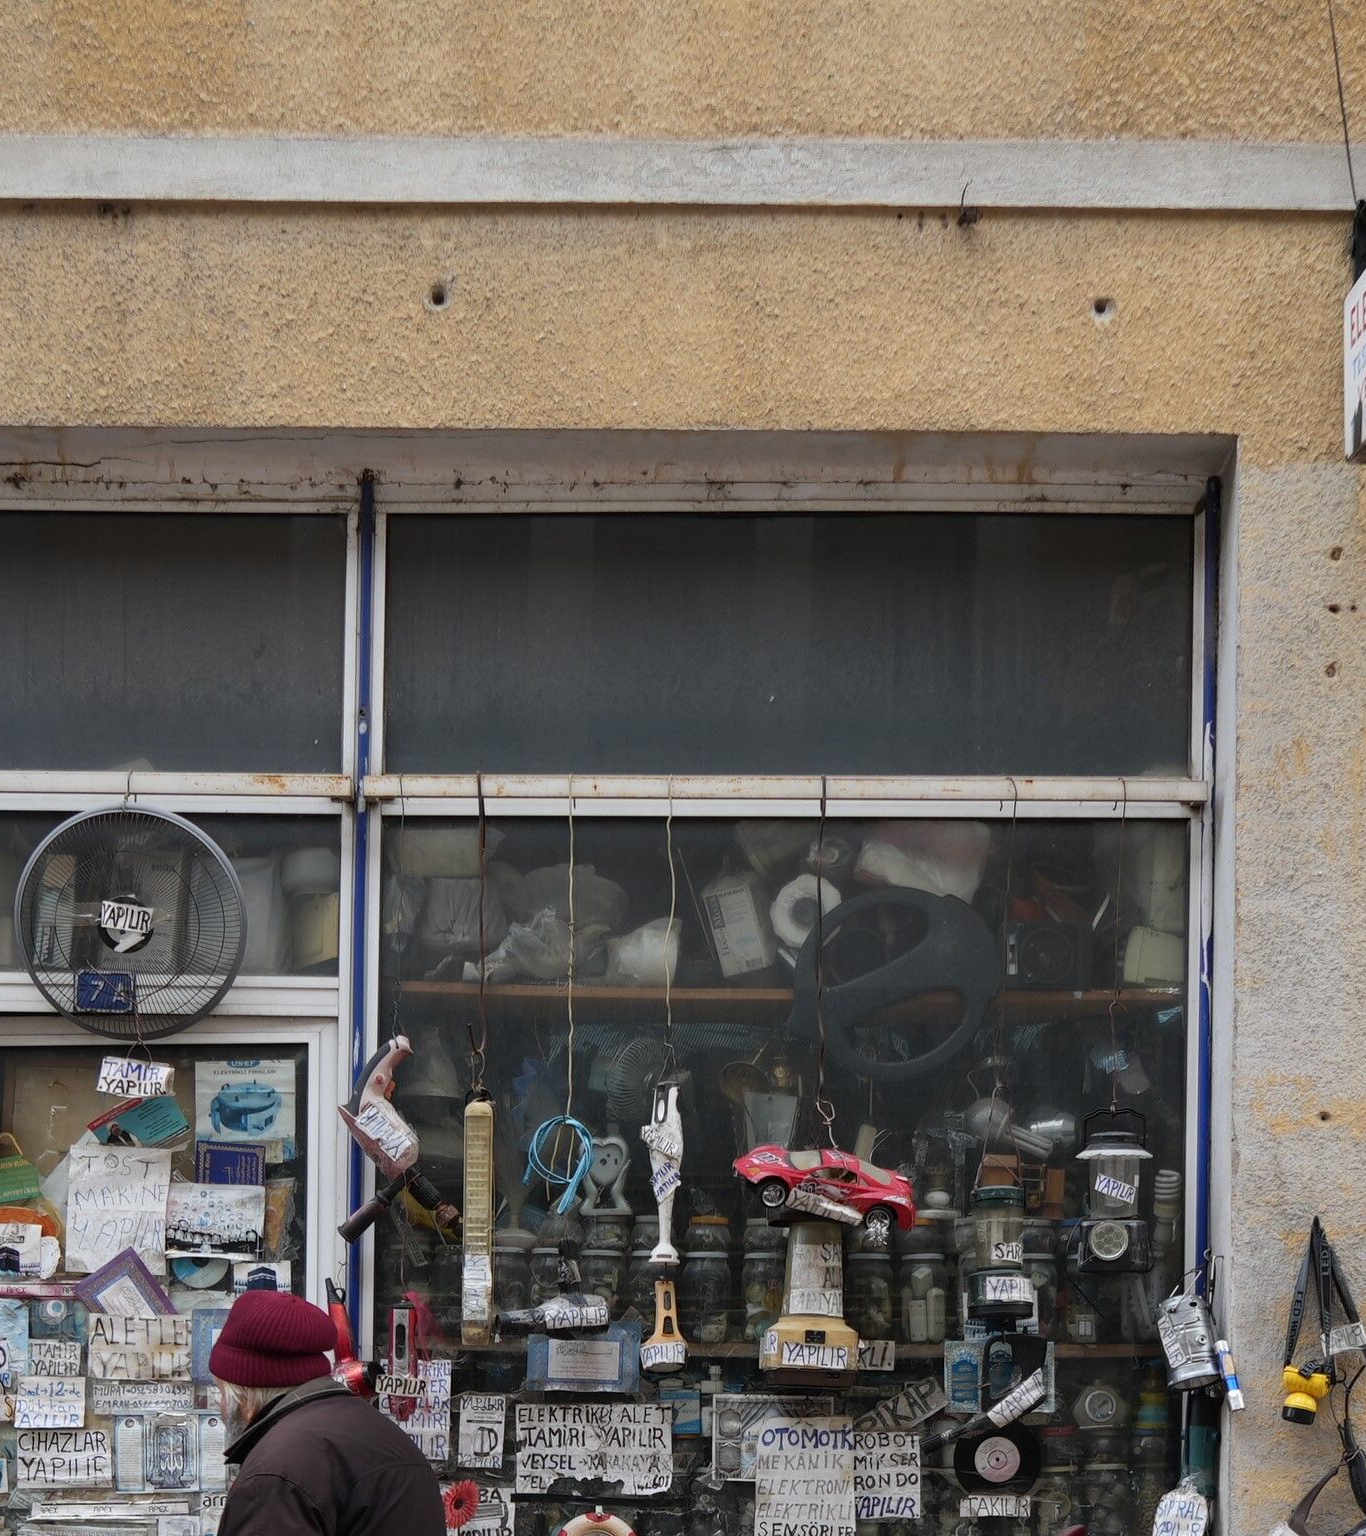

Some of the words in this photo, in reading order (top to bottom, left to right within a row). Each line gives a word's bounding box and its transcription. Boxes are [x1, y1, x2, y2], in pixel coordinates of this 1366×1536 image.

[102, 904, 150, 932] YAPILIR
[91, 981, 104, 1001] 7
[84, 1154, 159, 1175] TOST
[1096, 1175, 1134, 1201] YAPILIR
[548, 1308, 607, 1327] YAPILIR
[641, 1344, 685, 1365] YAPILIR
[783, 1344, 847, 1366] YAPILIR
[620, 1407, 671, 1424] ALET
[19, 1431, 106, 1452] CİHAZLAR
[521, 1425, 585, 1447] TAMİRİ
[854, 1433, 918, 1449] ROBOT
[522, 1454, 576, 1470] VEYSEL
[854, 1473, 918, 1491] RONDO
[757, 1500, 851, 1521] ELEKTRİKLİ
